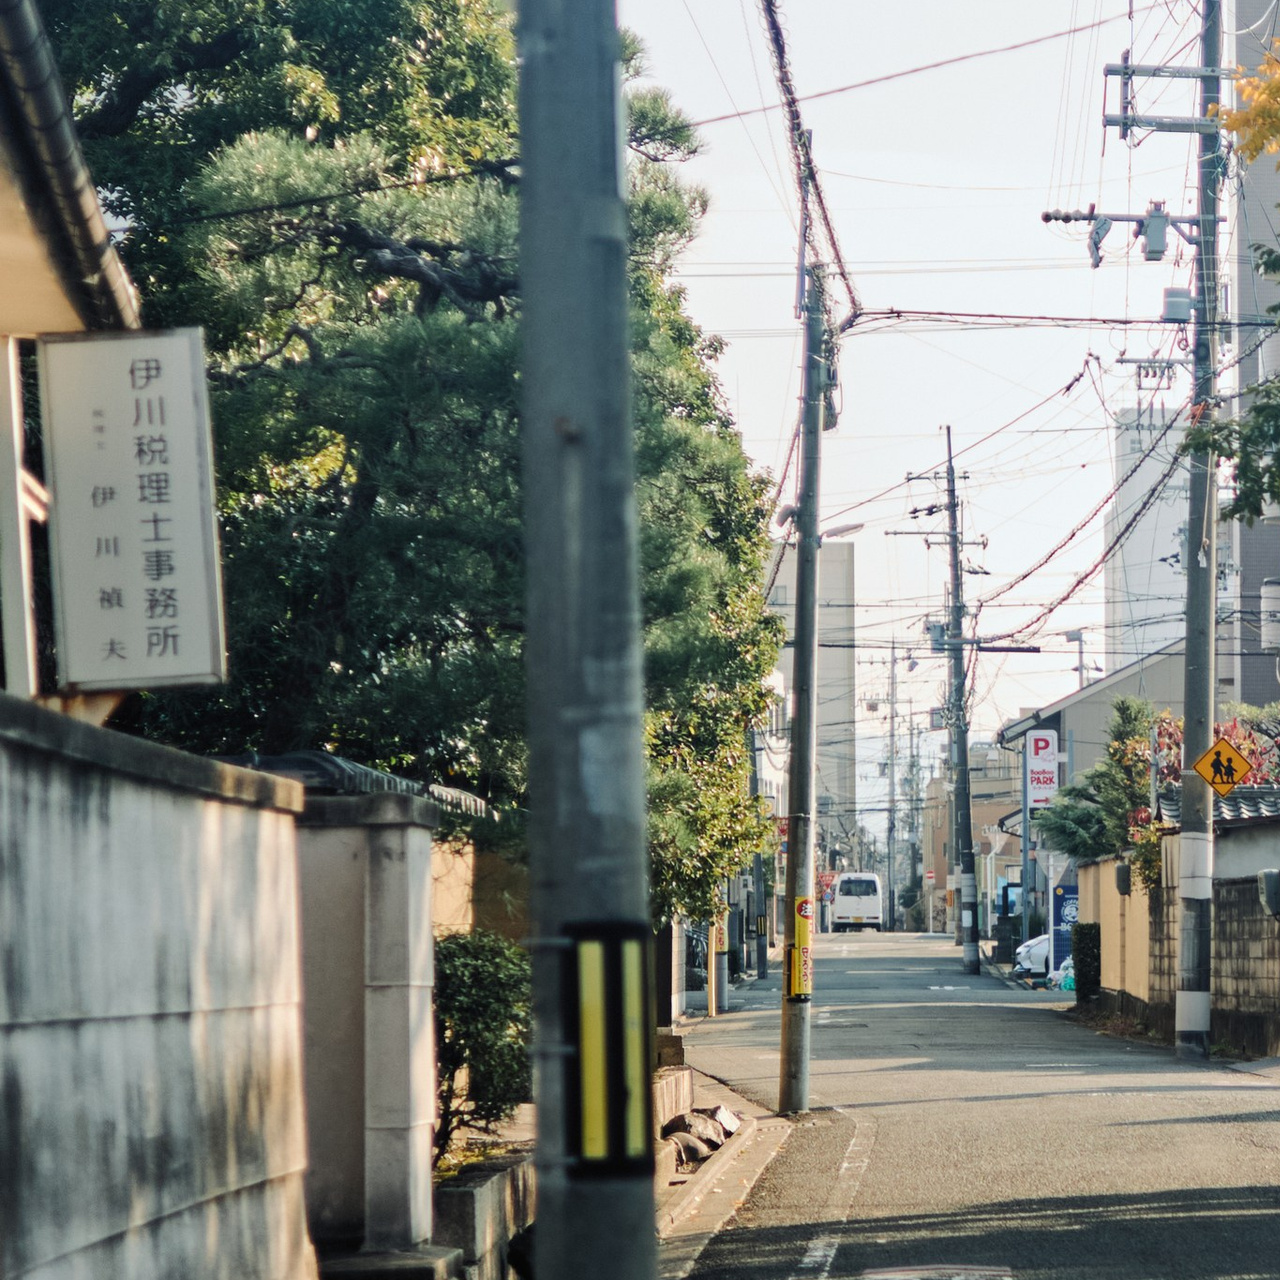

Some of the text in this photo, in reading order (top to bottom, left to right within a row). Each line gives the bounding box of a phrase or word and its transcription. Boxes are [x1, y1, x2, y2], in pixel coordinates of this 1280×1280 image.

[128, 357, 181, 658] 伊川税理士事務所
[1033, 737, 1050, 756] P
[1030, 776, 1055, 786] PARK
